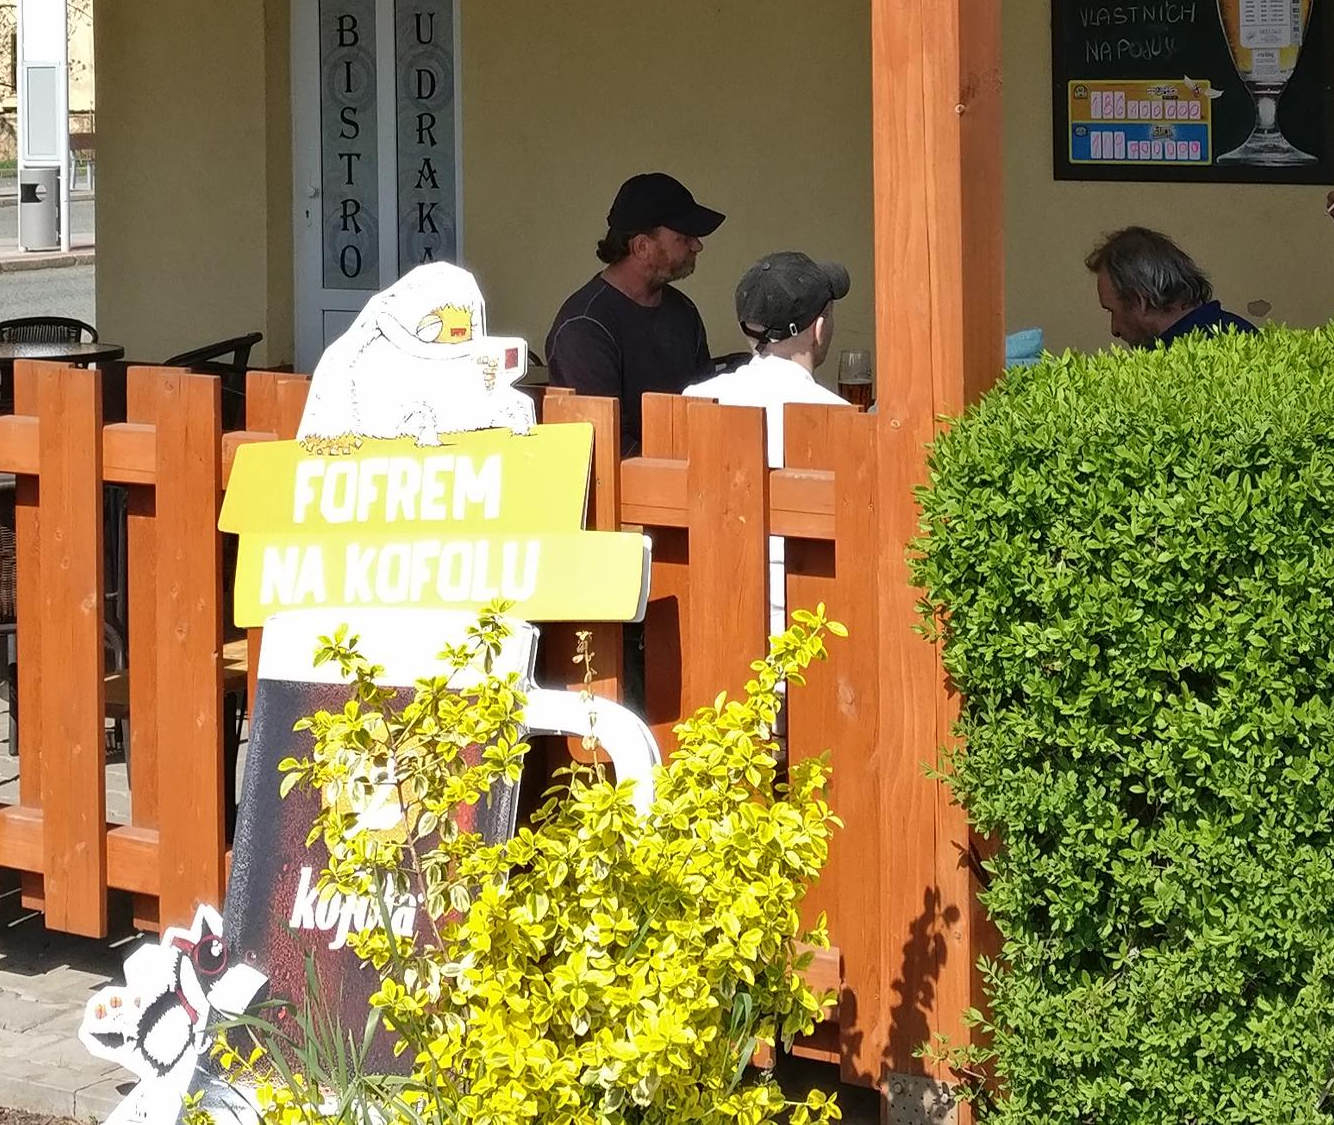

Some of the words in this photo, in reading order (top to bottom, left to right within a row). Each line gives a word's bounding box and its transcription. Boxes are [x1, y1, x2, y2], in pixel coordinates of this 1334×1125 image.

[414, 12, 436, 45] U
[336, 13, 363, 279] BISTRO
[292, 454, 502, 524] FOFREM
[260, 545, 327, 606] NA
[344, 539, 541, 604] KOFOLU
